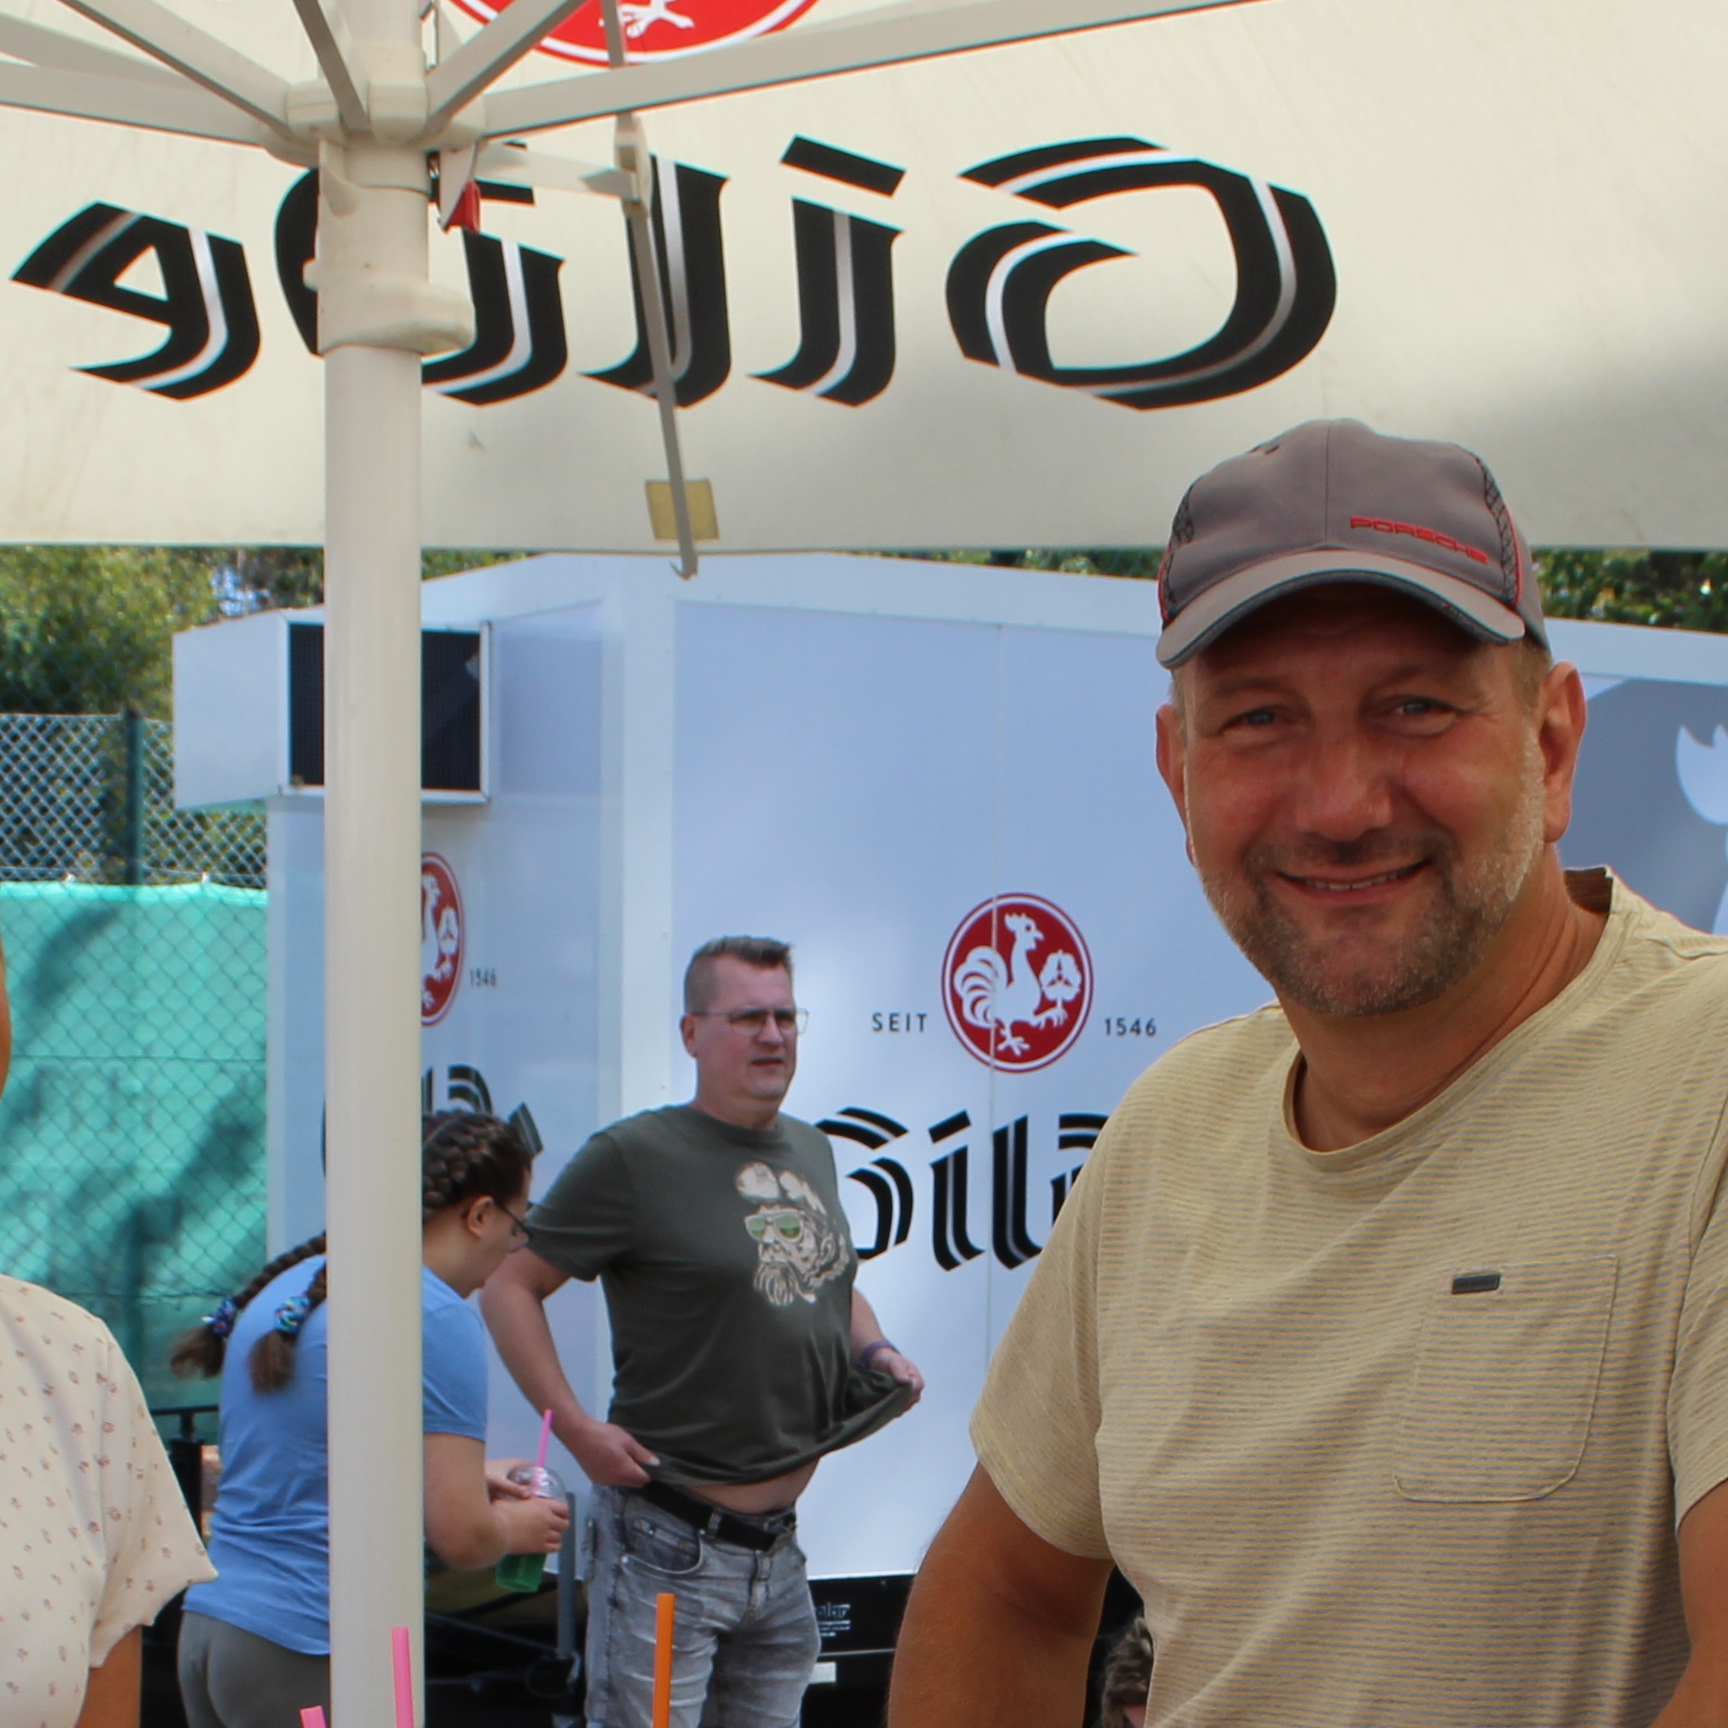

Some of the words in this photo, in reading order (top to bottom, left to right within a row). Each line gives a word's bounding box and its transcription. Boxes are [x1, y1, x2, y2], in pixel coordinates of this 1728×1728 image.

[1350, 516, 1488, 564] PORSCHE
[470, 968, 496, 986] 1546
[871, 1011, 928, 1032] SEIT
[1104, 1017, 1157, 1037] 1546
